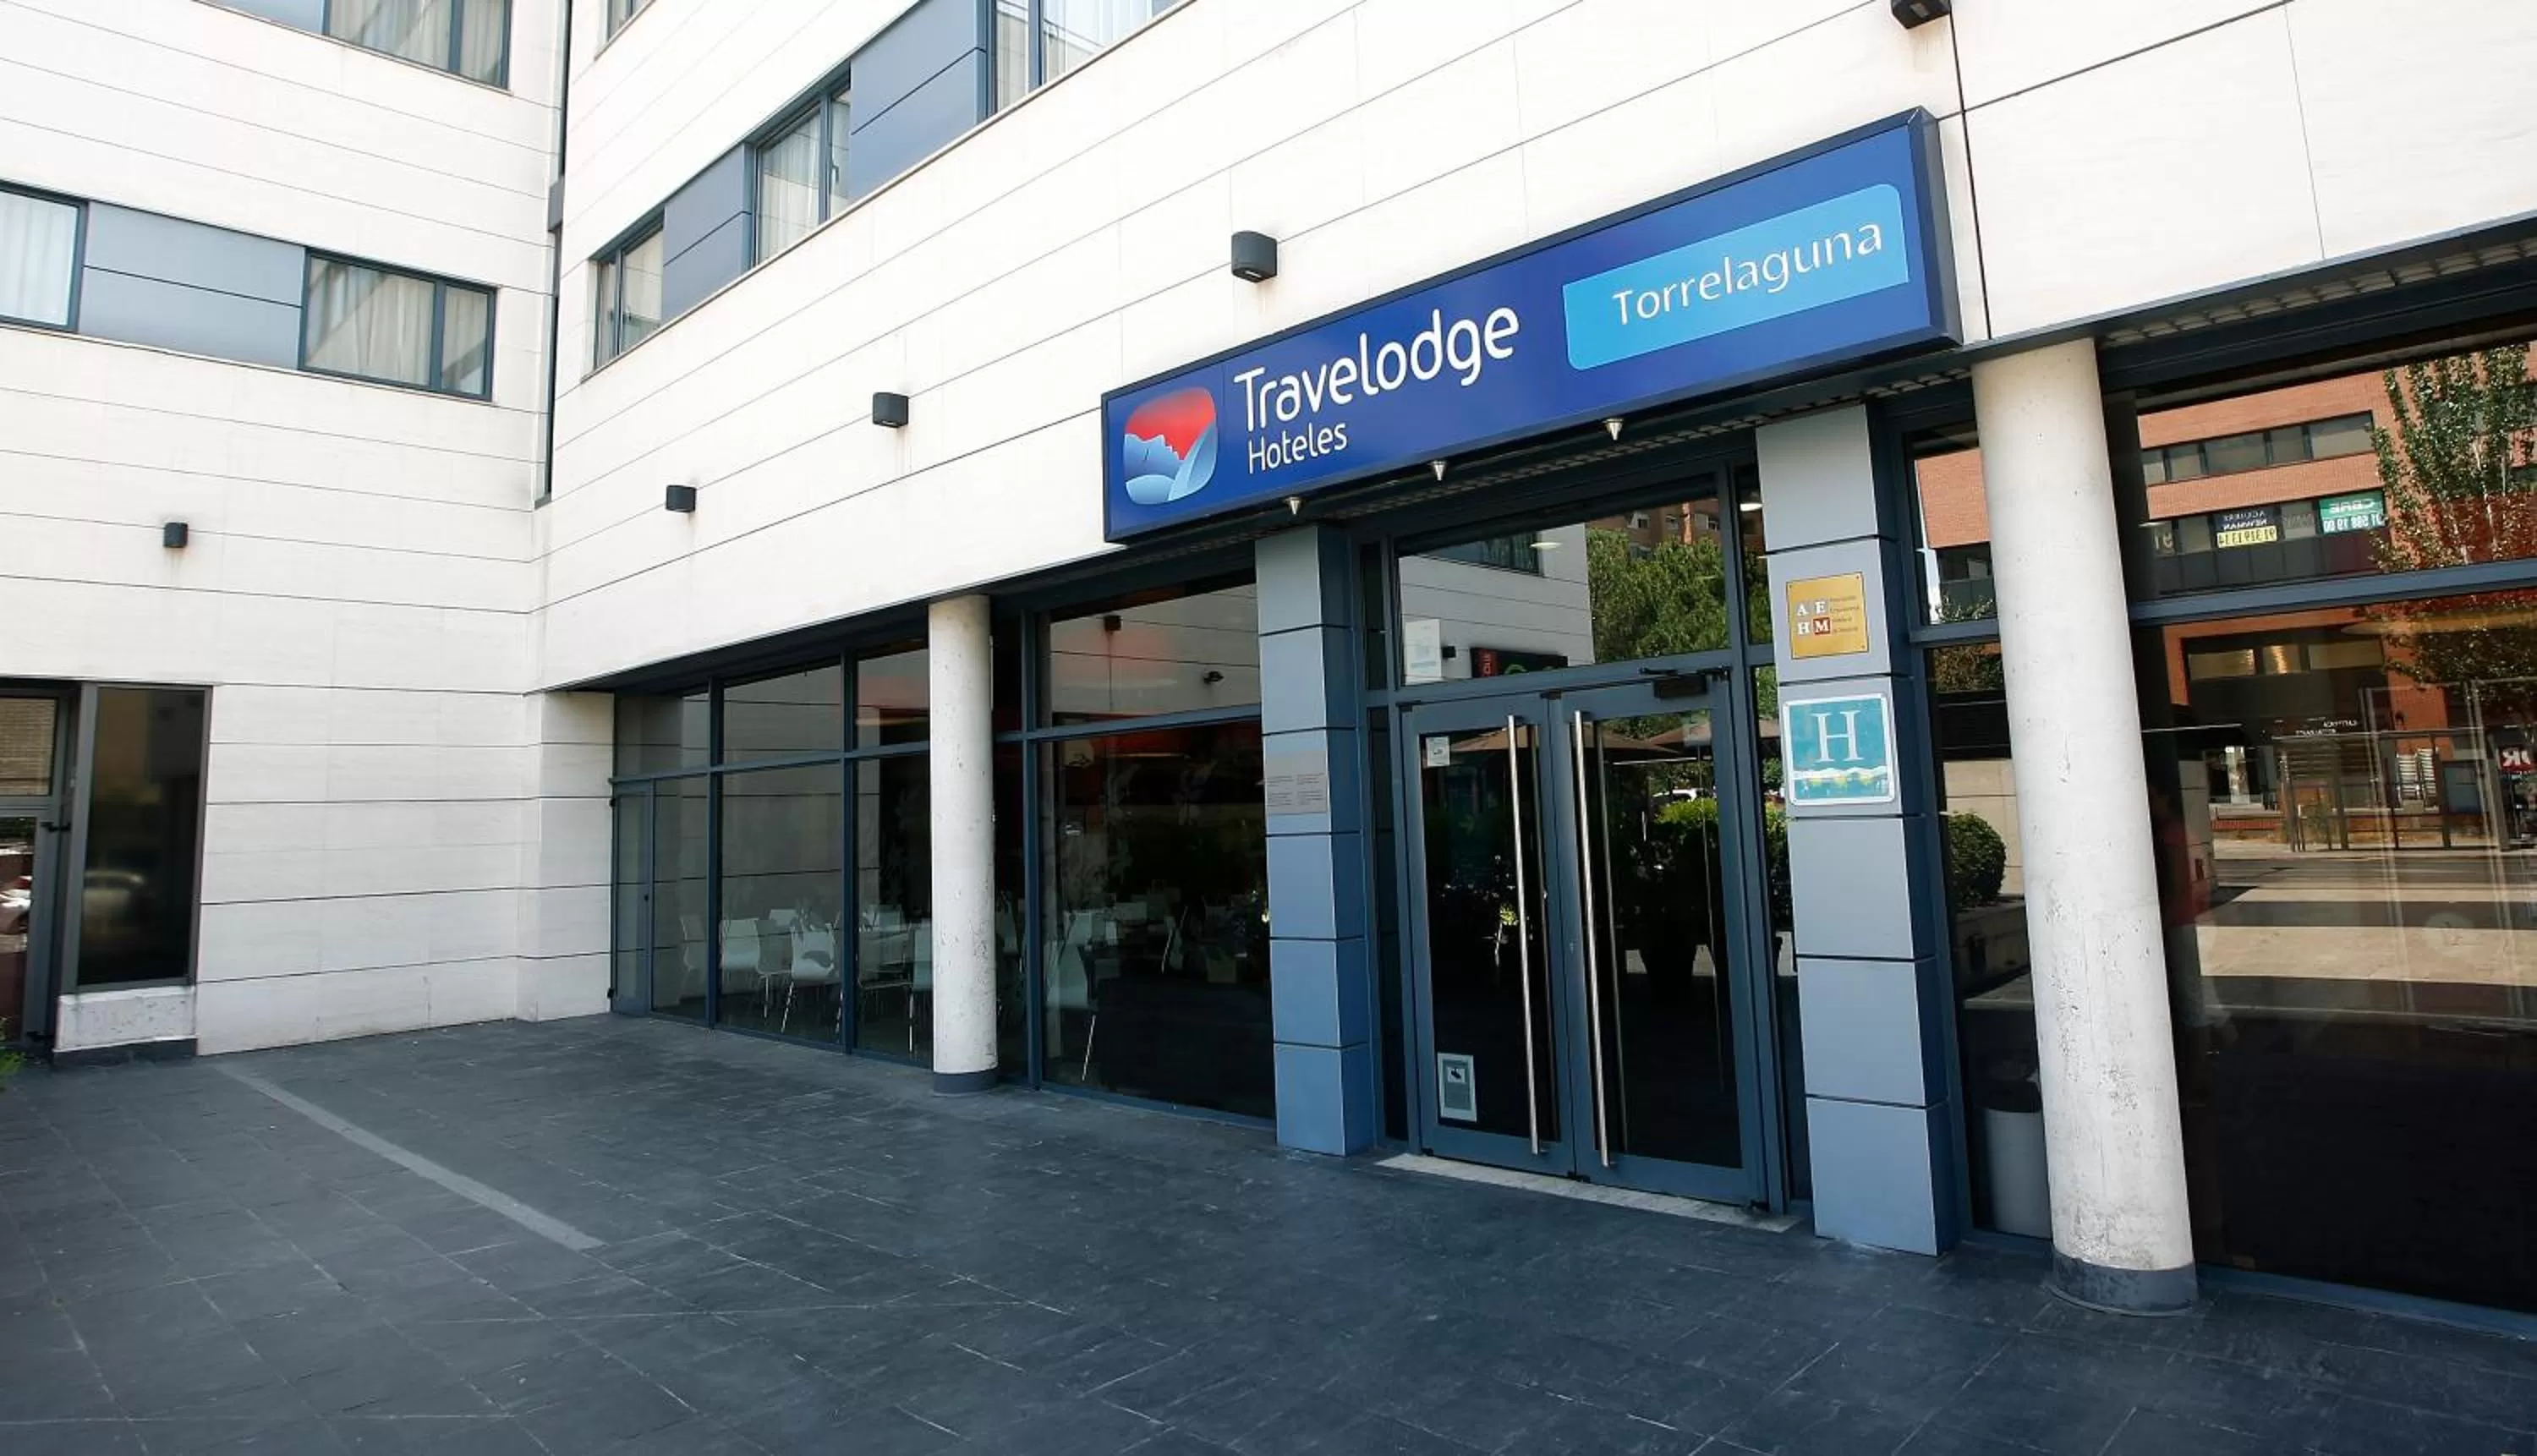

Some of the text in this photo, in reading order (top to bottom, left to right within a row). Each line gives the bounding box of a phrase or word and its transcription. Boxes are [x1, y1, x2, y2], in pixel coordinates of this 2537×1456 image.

[1612, 222, 1882, 325] Torrelaguna
[1233, 307, 1520, 432] Travelodge
[1247, 422, 1348, 474] Hoteles
[1809, 709, 1865, 763] H
